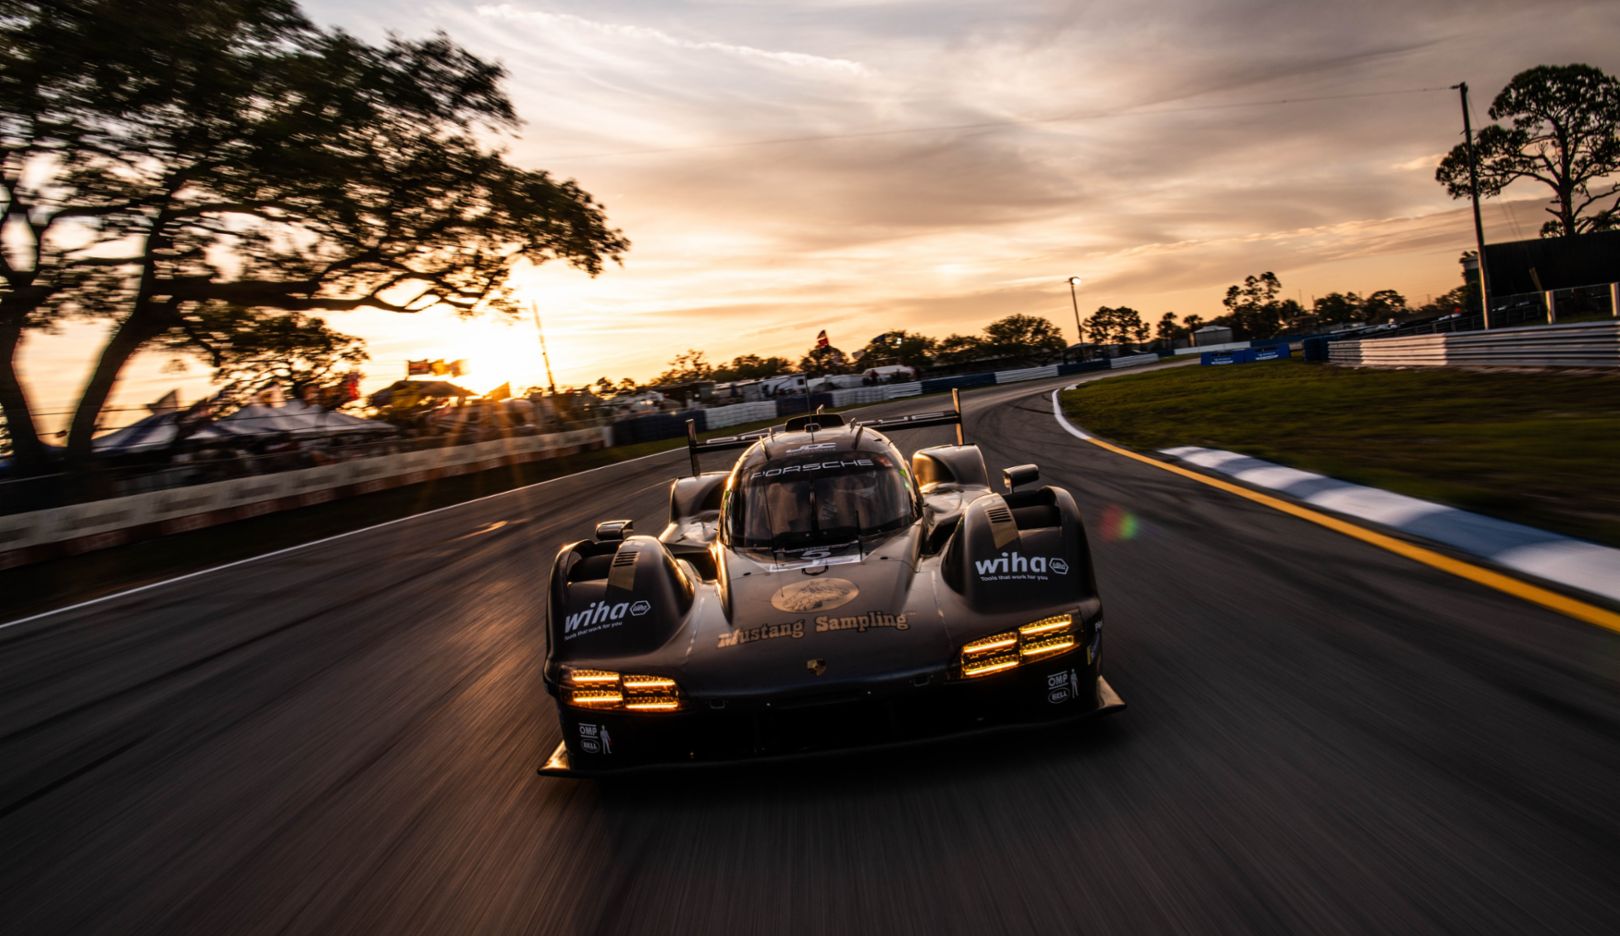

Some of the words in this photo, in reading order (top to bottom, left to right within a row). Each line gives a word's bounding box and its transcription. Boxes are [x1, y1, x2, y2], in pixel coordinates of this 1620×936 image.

[750, 458, 875, 480] PORSCHE
[975, 551, 1047, 575] wiha
[564, 600, 630, 634] wiha
[717, 620, 805, 649] Mustang
[815, 611, 909, 632] Sampling
[1048, 673, 1068, 687] OMP
[579, 726, 597, 737] OMP
